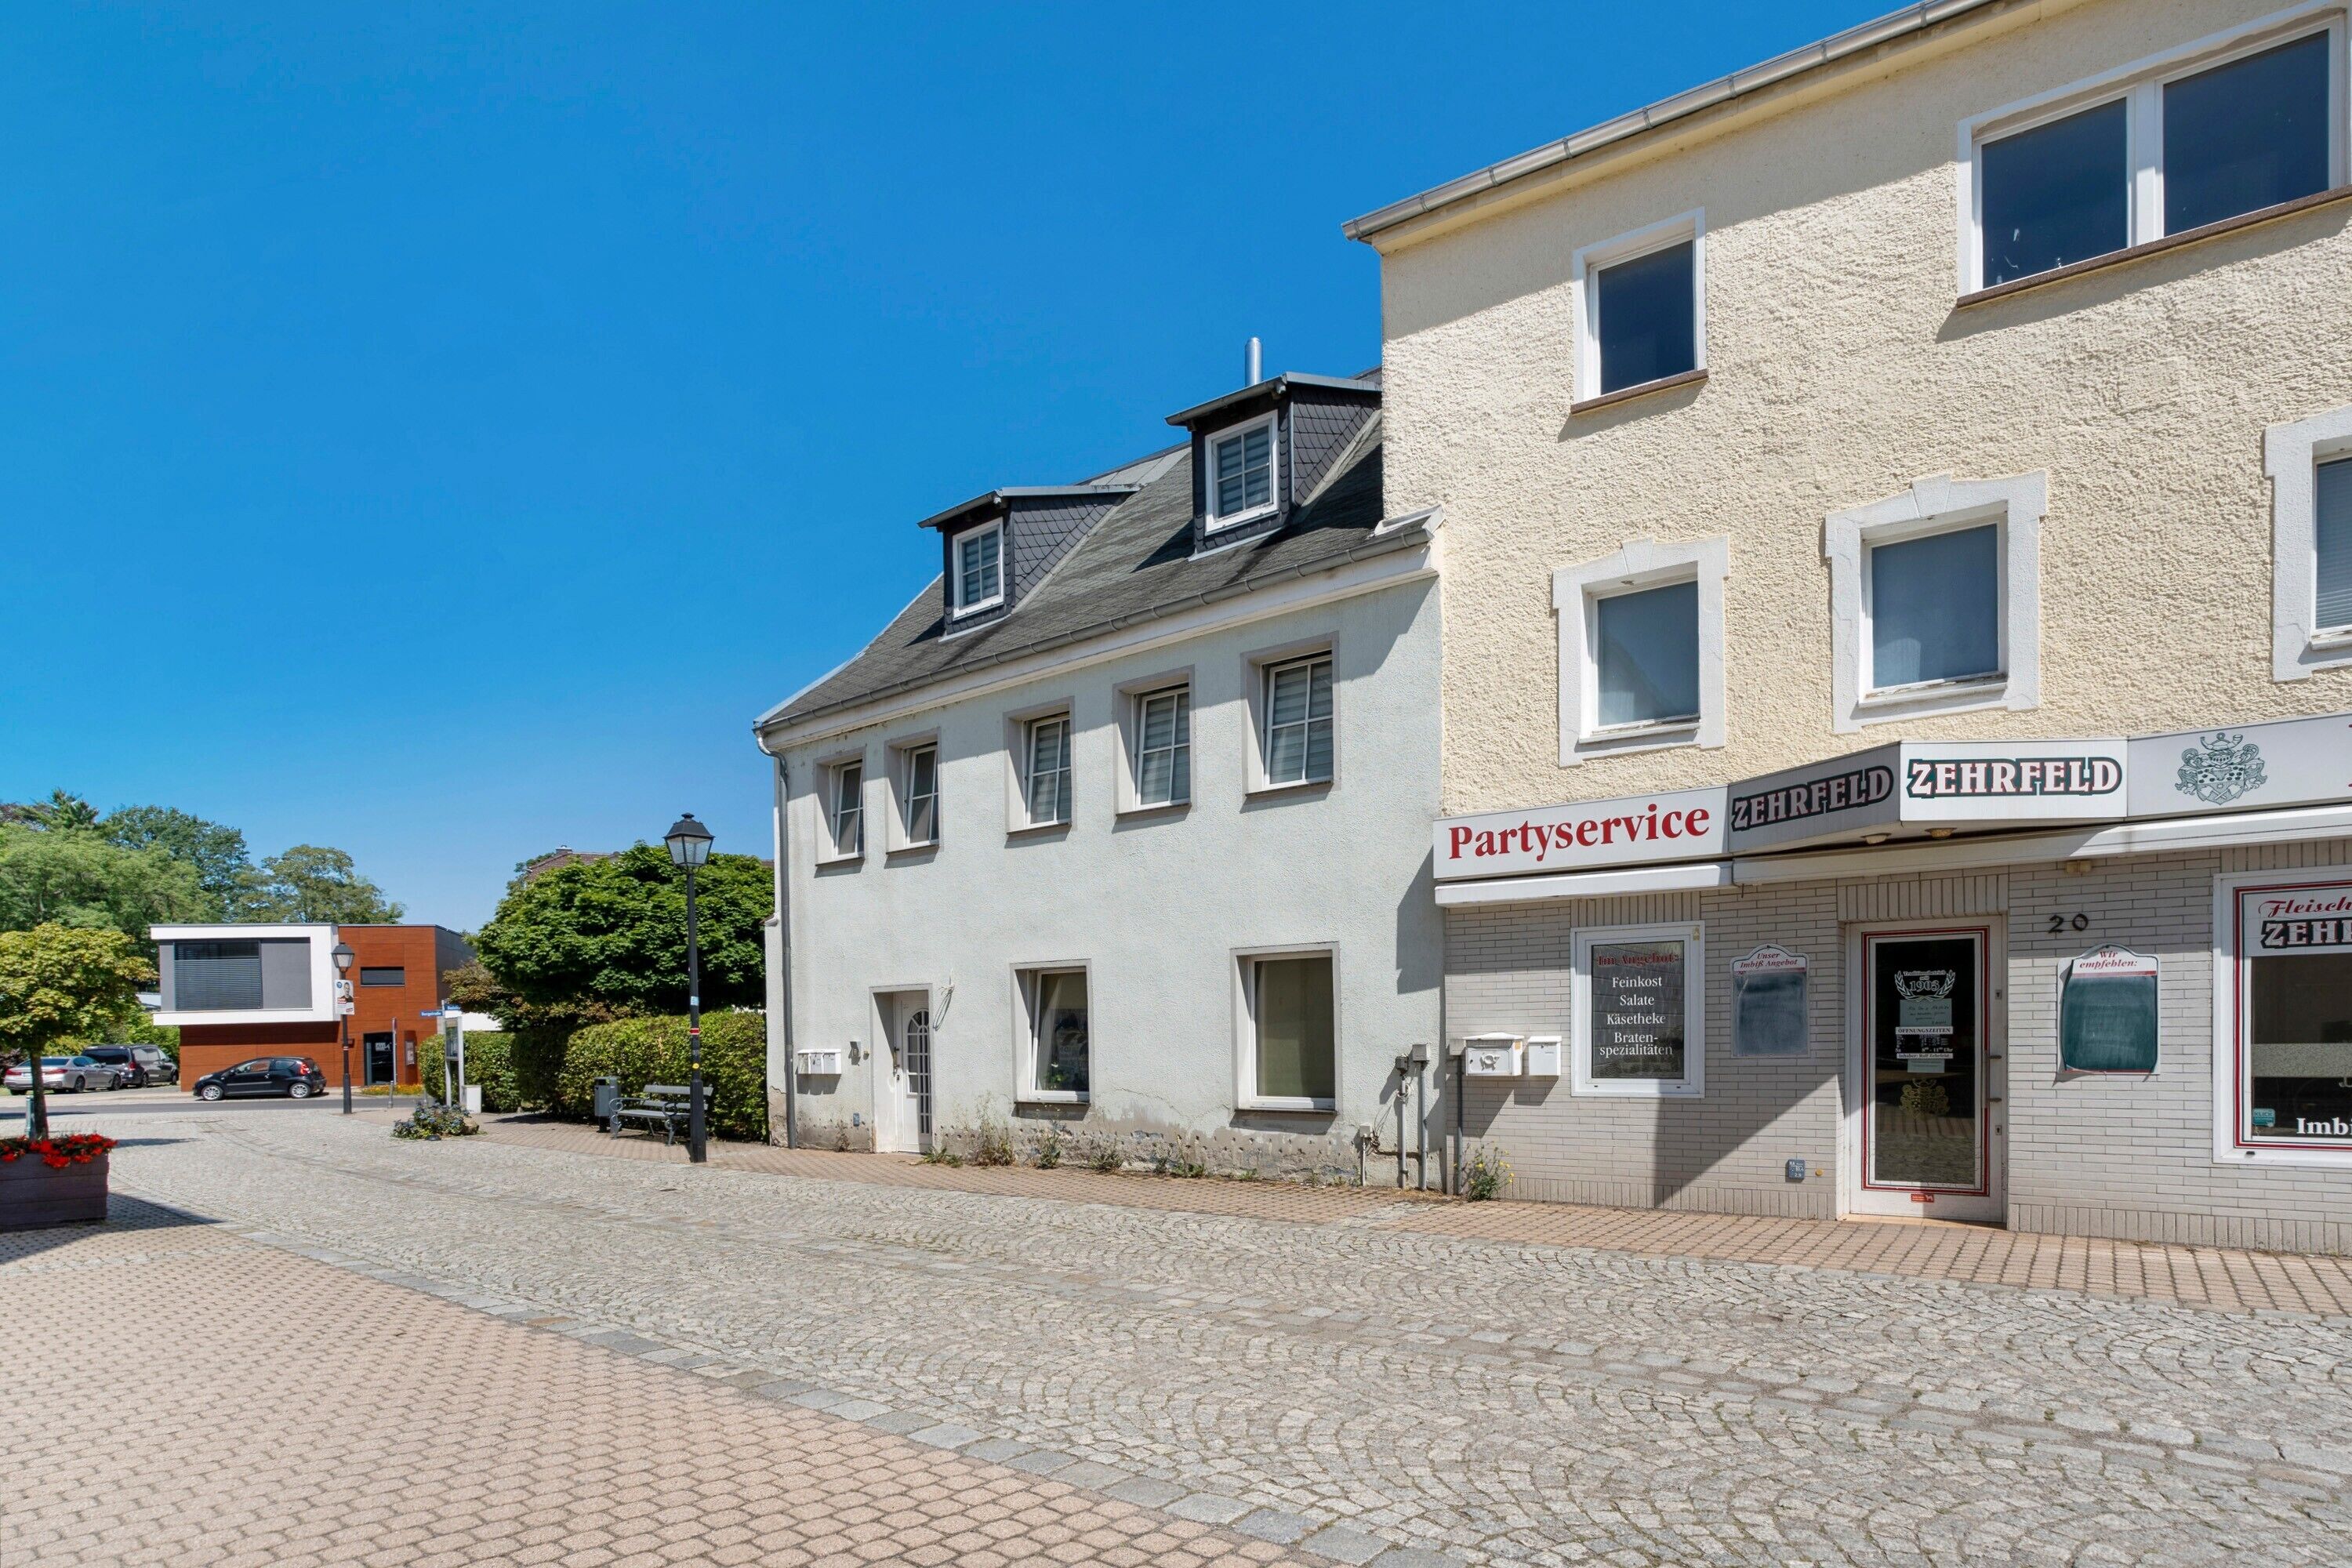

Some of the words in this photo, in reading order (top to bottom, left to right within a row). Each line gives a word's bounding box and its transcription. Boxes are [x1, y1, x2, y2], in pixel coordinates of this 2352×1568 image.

[1909, 759, 2120, 797] ZEHRFELD
[1733, 768, 1891, 829] ZEHRFELD
[1449, 803, 1710, 862] Partyservice
[2049, 913, 2088, 934] 20
[1597, 954, 1616, 966] Im
[1740, 960, 1764, 968] Imbiß
[2079, 959, 2137, 970] empfehlen:
[1612, 975, 1662, 988] Feinkost
[1620, 994, 1655, 1006] Salate
[1606, 1013, 1666, 1025] Käsetheke
[1614, 1032, 1658, 1044] Braten-
[1599, 1044, 1673, 1058] spezialitäten
[2296, 1117, 2352, 1135] Imb
